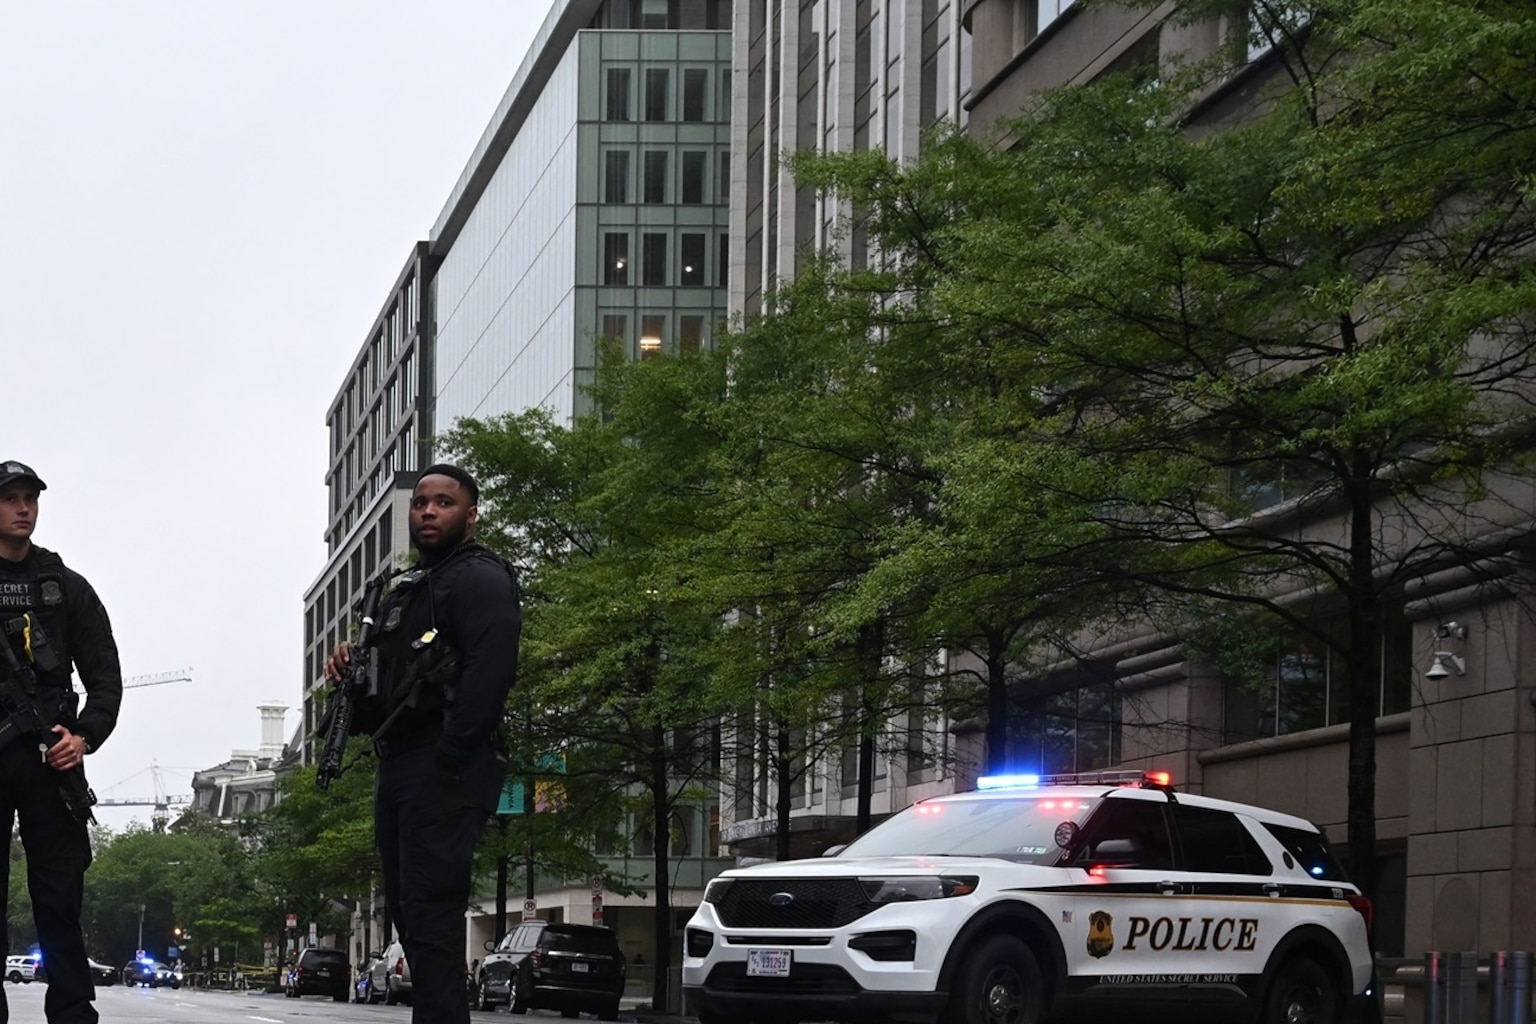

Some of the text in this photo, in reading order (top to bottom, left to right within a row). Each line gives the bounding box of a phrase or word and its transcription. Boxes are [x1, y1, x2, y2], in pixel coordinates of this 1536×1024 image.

[1122, 916, 1259, 951] POLICE
[1099, 974, 1238, 984] UNITED STATES SECRET SERVICE
